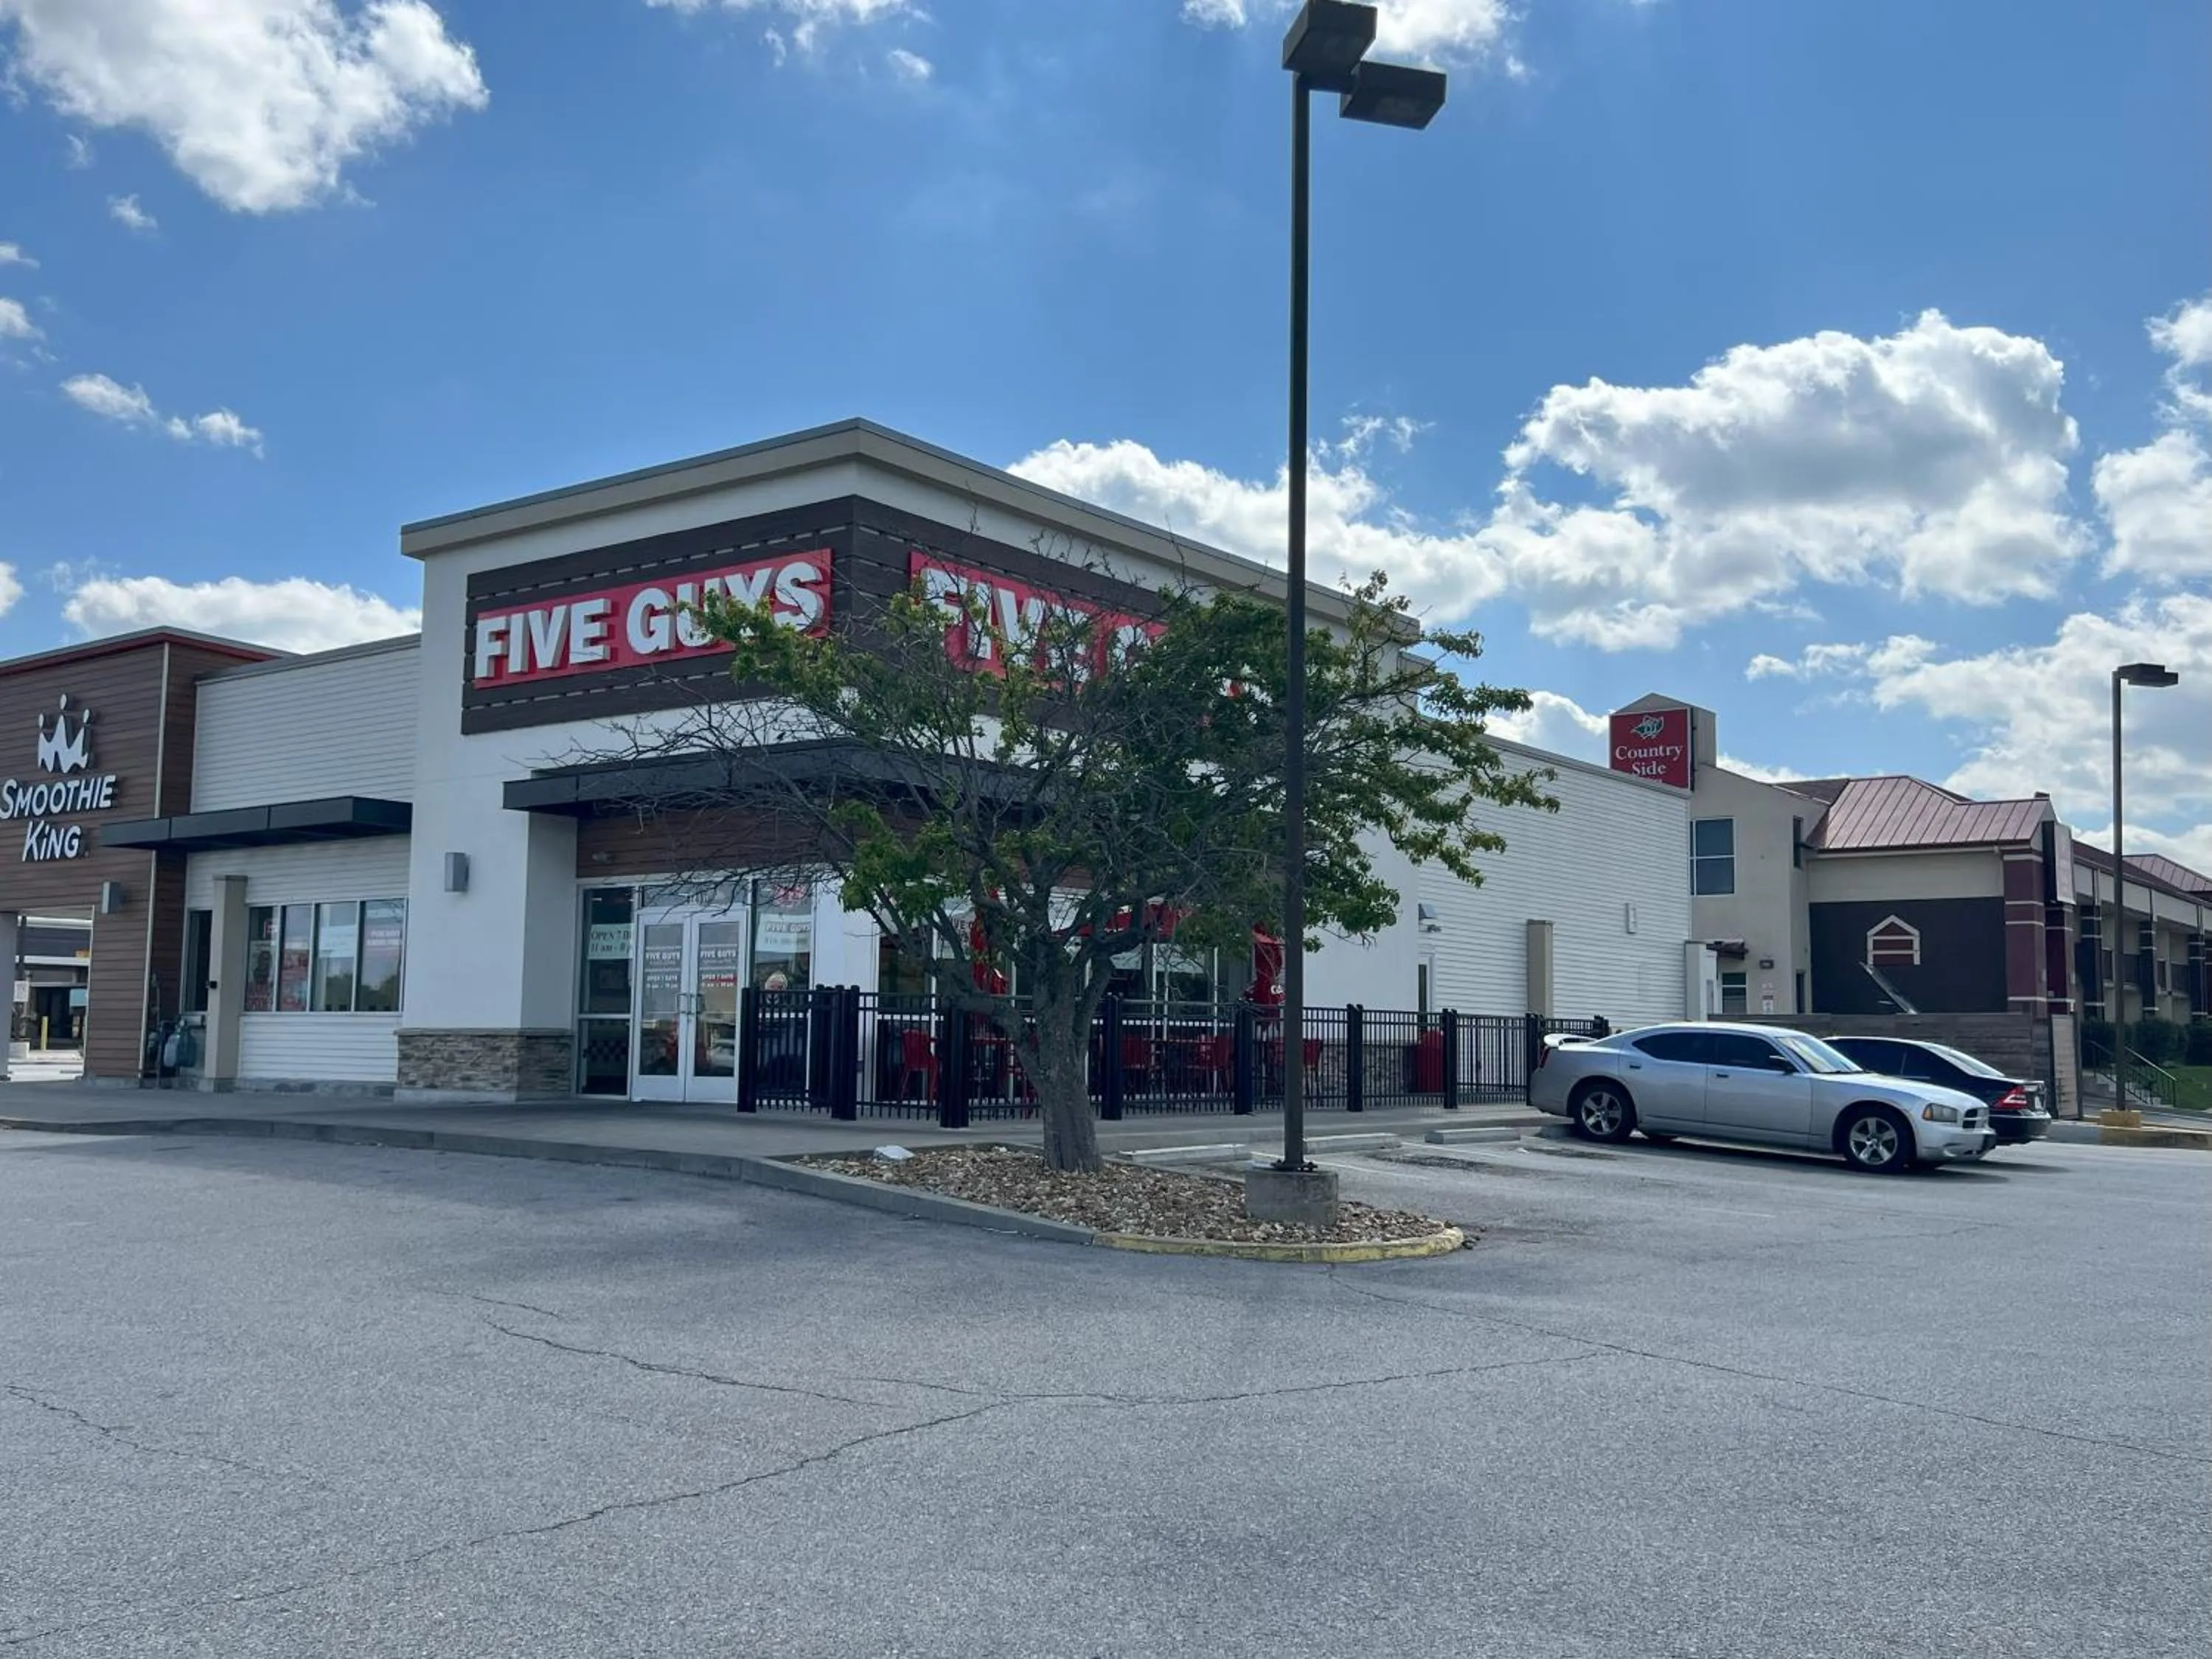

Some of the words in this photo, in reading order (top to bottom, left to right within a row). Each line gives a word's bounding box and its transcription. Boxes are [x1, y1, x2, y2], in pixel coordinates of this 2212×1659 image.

[475, 597, 611, 679] FIVE
[626, 561, 823, 655] GUYS
[1615, 744, 1683, 761] Country
[1632, 760, 1666, 776] Side
[0, 775, 116, 819] SMOOTHIE
